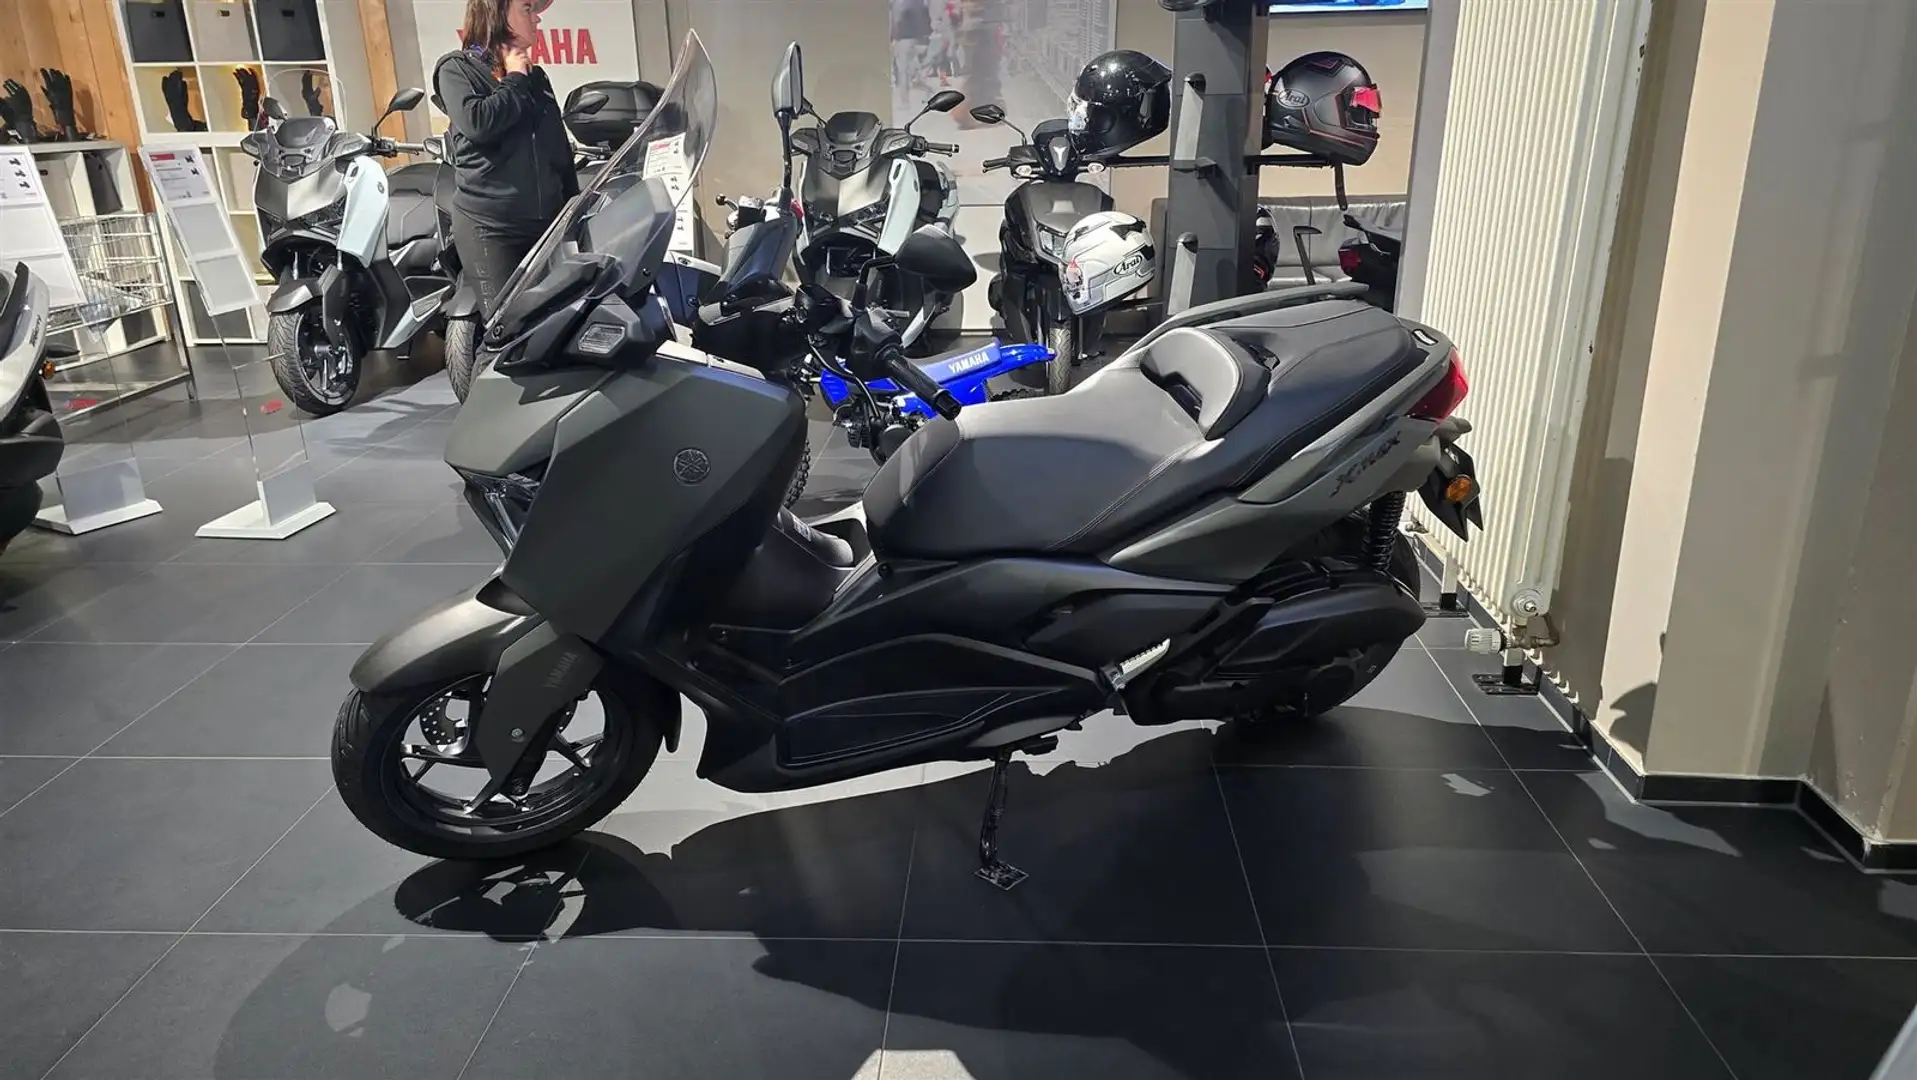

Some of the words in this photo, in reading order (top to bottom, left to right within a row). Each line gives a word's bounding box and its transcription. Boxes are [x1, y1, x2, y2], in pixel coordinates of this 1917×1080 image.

[456, 29, 597, 64] AHA
[947, 351, 990, 375] YAMAHA
[542, 651, 579, 688] YAMAHA
